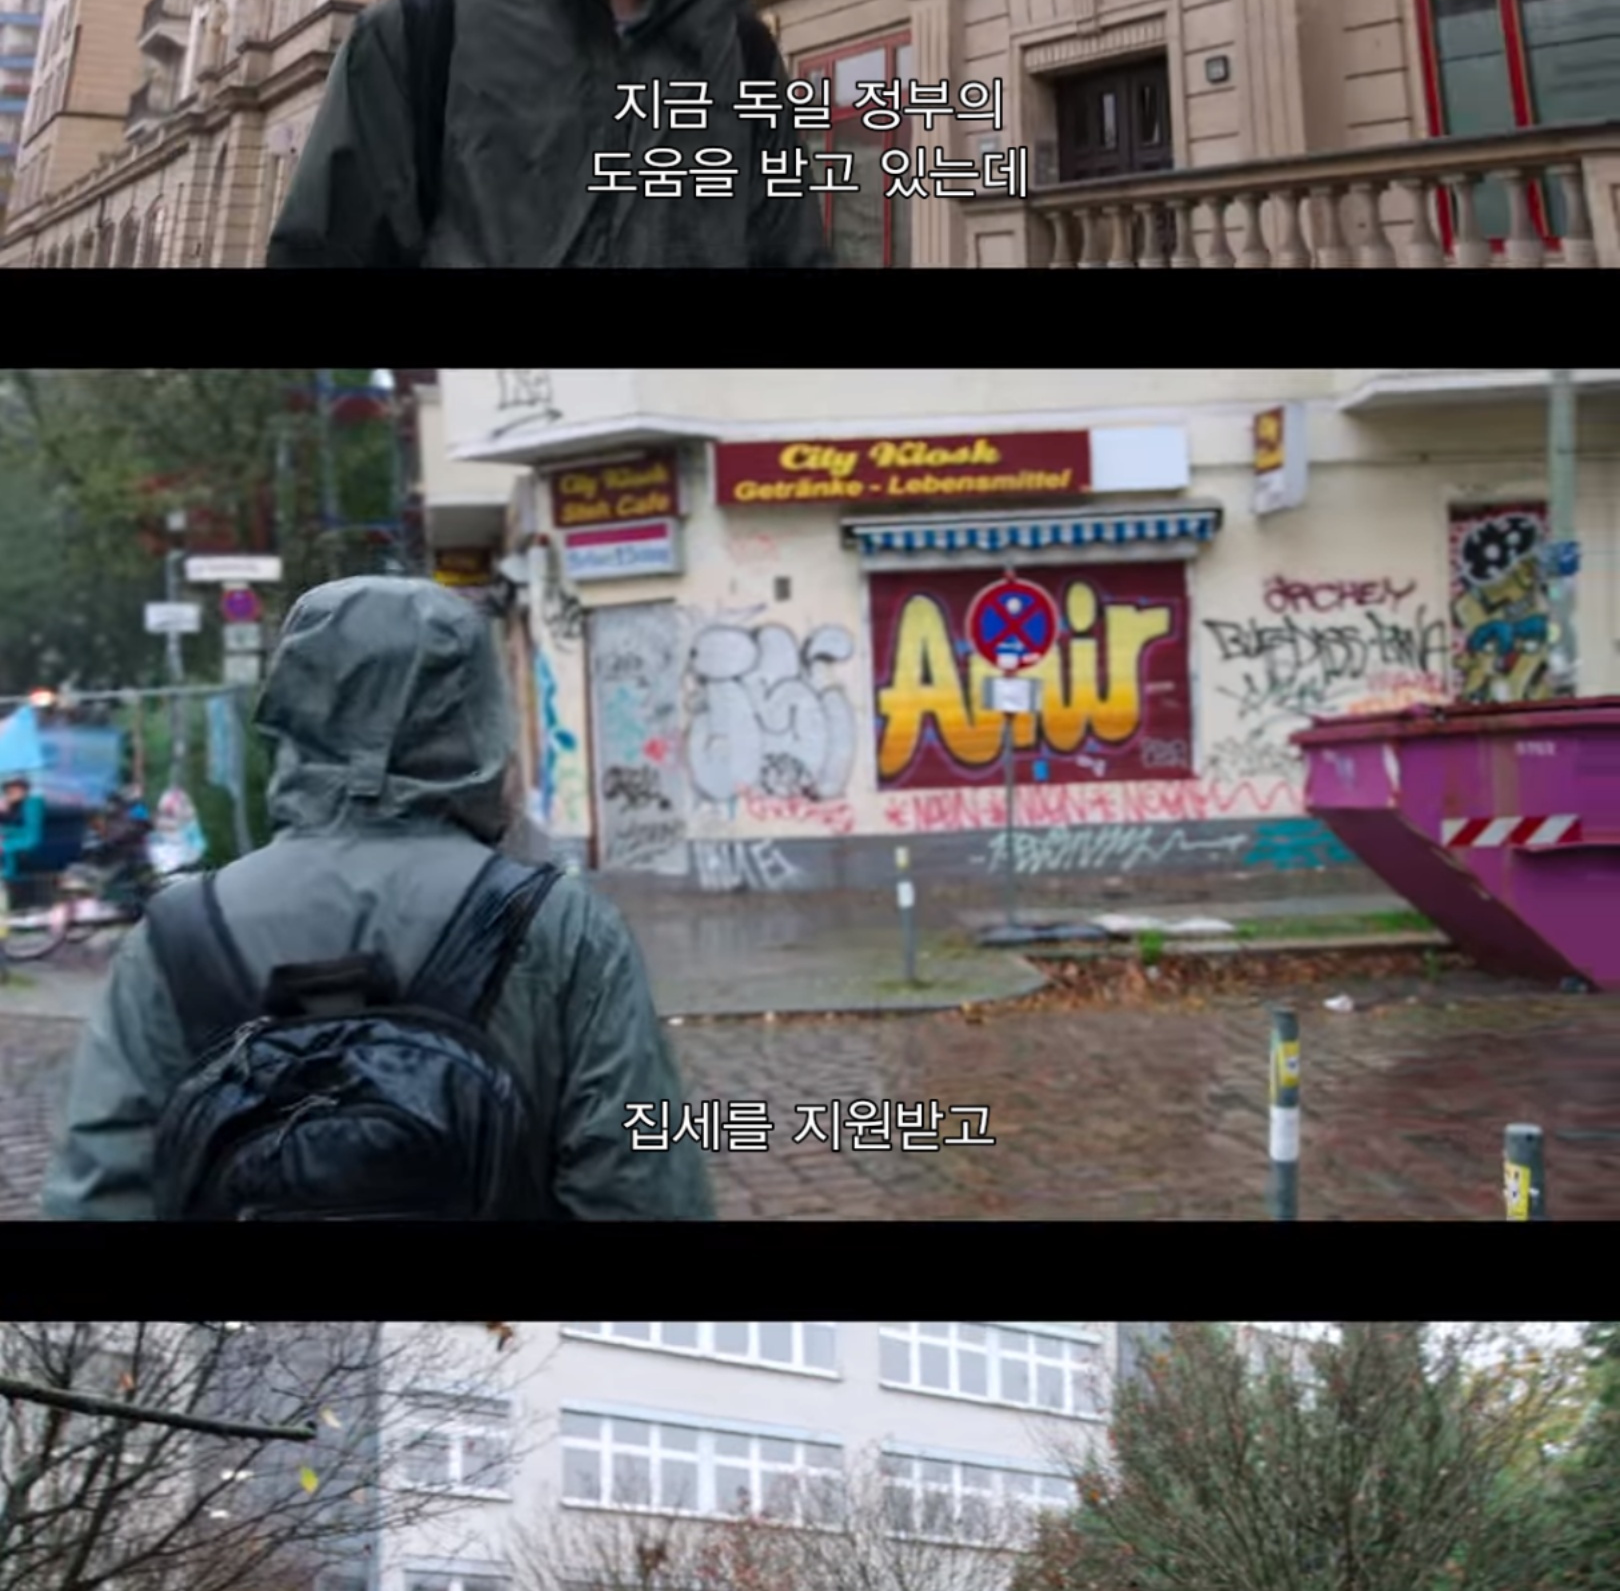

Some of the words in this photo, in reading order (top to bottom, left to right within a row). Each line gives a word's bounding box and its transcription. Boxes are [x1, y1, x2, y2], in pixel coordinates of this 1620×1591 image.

[779, 443, 858, 477] City
[869, 437, 1000, 469] Kiosk
[887, 468, 1073, 496] Lebensmittel
